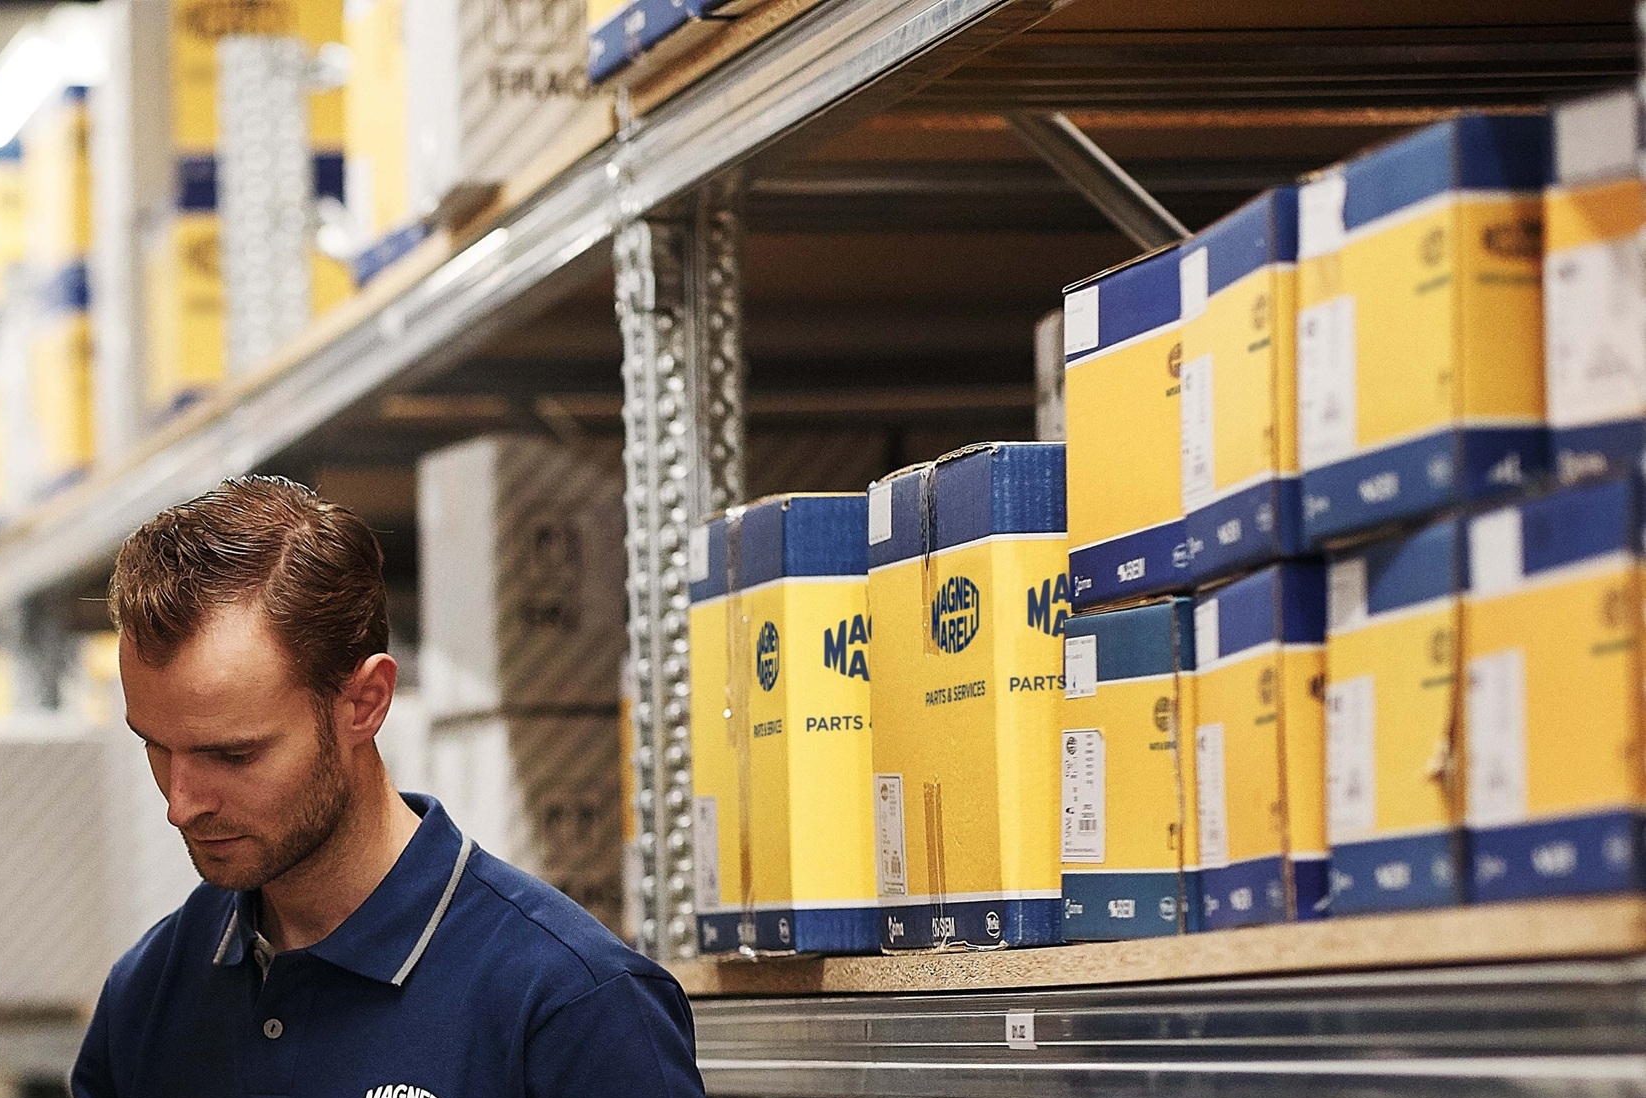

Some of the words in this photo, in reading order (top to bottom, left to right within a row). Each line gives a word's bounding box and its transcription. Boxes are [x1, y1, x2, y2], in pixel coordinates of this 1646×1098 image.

[932, 576, 980, 616] MAGNETI
[932, 605, 980, 654] MARELLI
[926, 689, 947, 707] PARTS
[947, 687, 953, 702] &
[954, 680, 986, 702] SERVICES
[1009, 675, 1067, 692] PARTS
[806, 715, 864, 732] PARTS
